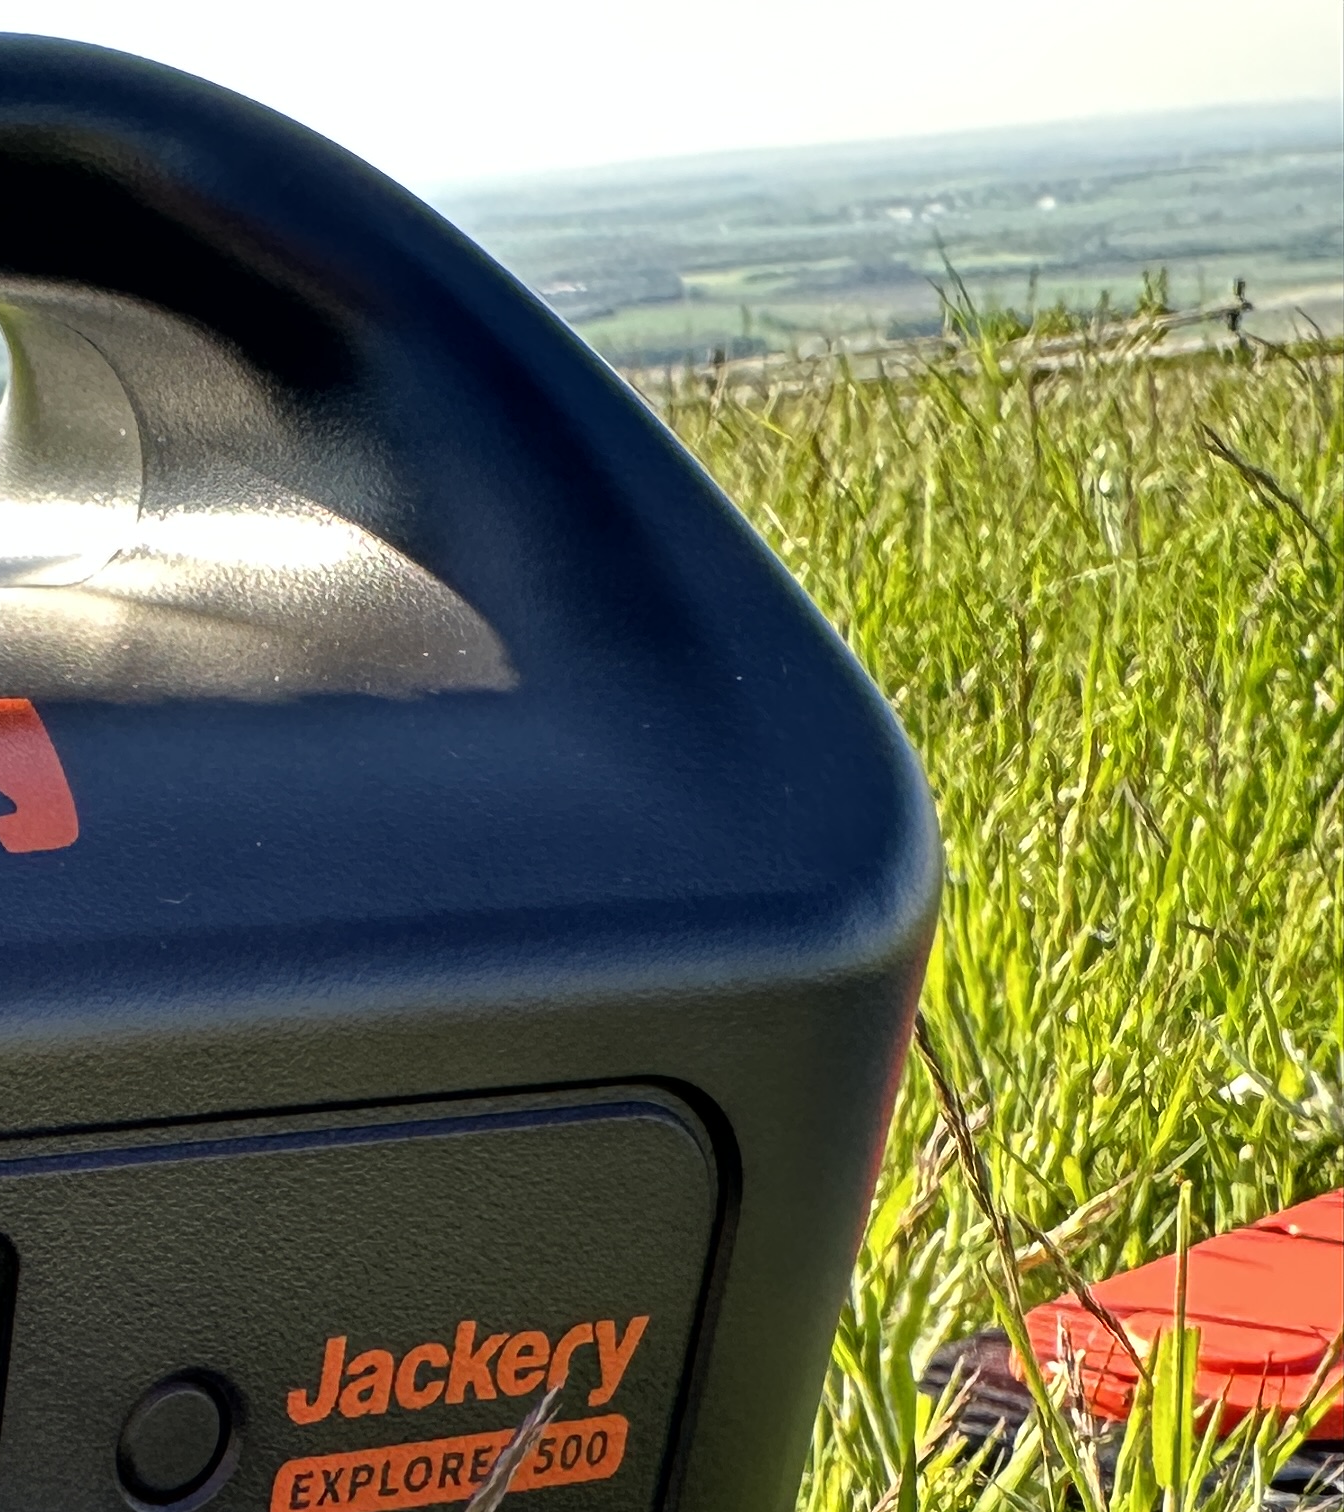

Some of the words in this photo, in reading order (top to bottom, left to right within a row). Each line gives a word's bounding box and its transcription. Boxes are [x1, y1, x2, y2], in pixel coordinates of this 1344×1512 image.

[286, 1315, 650, 1425] Jackery
[288, 1443, 504, 1511] EXPLORE
[533, 1430, 608, 1475] 500
